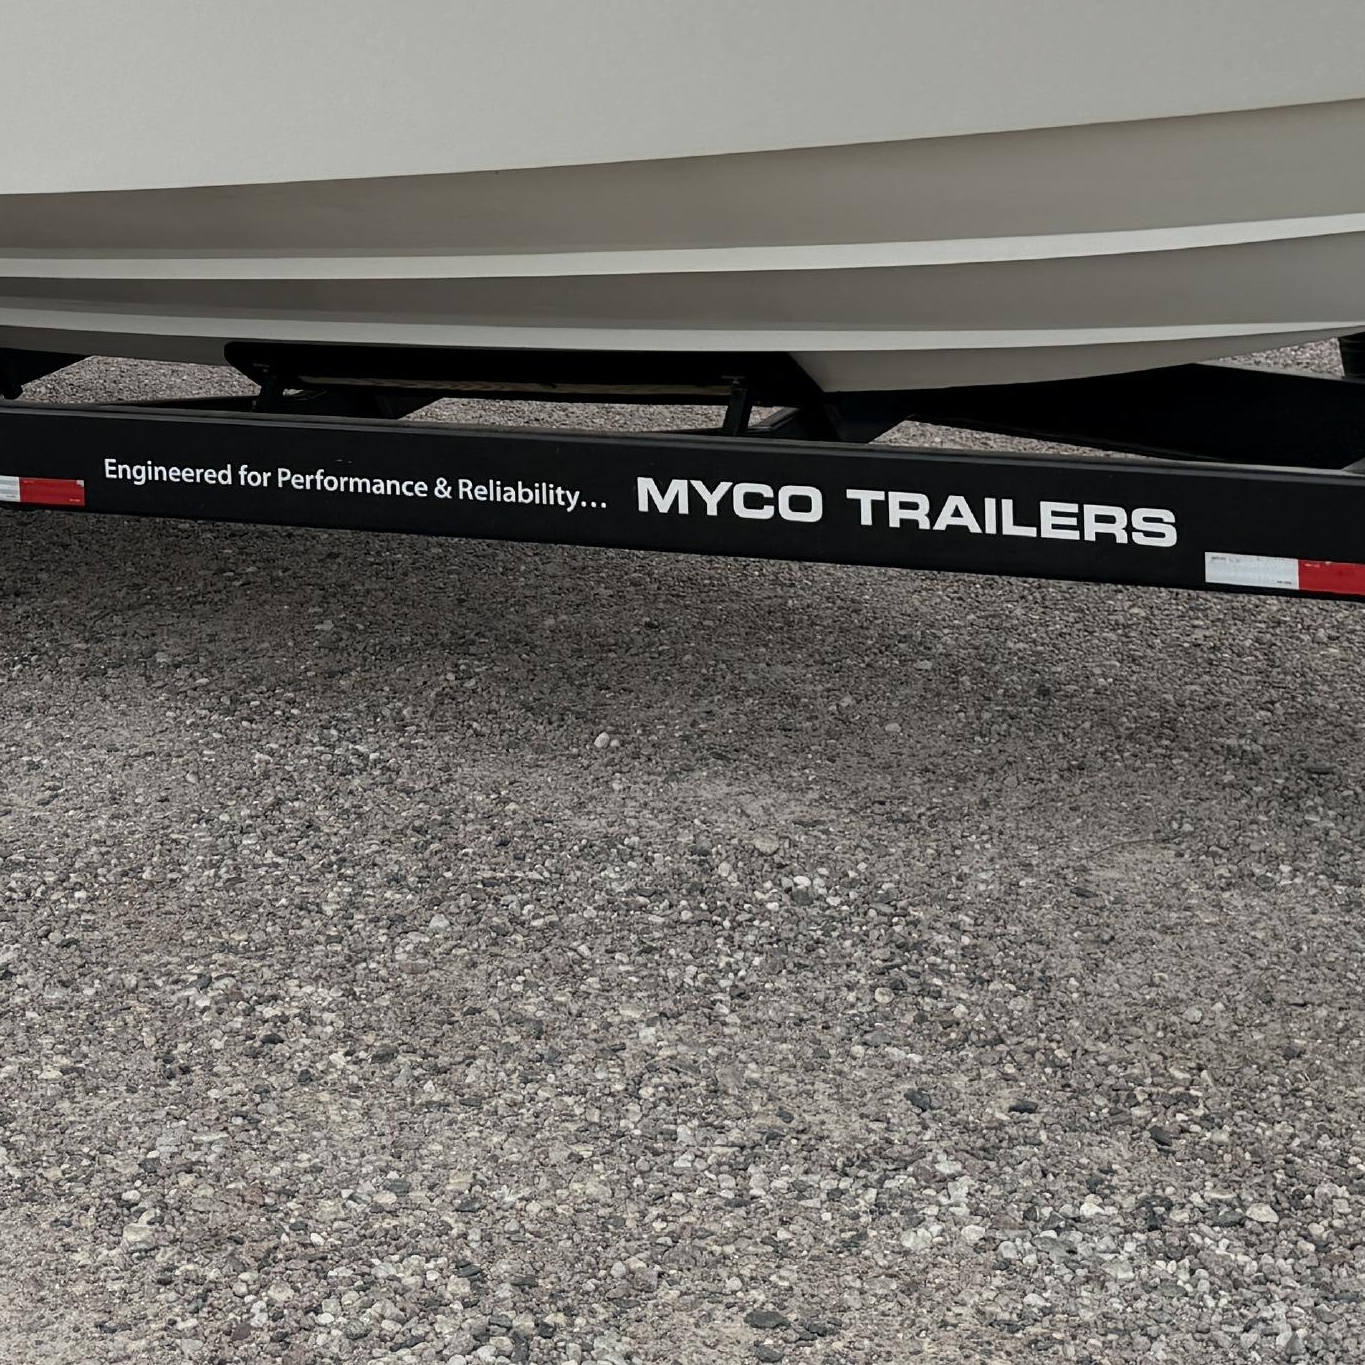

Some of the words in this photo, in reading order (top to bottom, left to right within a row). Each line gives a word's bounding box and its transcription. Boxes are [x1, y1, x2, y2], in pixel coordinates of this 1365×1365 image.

[104, 458, 233, 486] Engineered
[238, 464, 272, 488] for
[277, 467, 429, 498] Performance
[434, 477, 453, 500] &
[636, 476, 823, 523] MYCO
[845, 488, 1178, 548] TRAILERS
